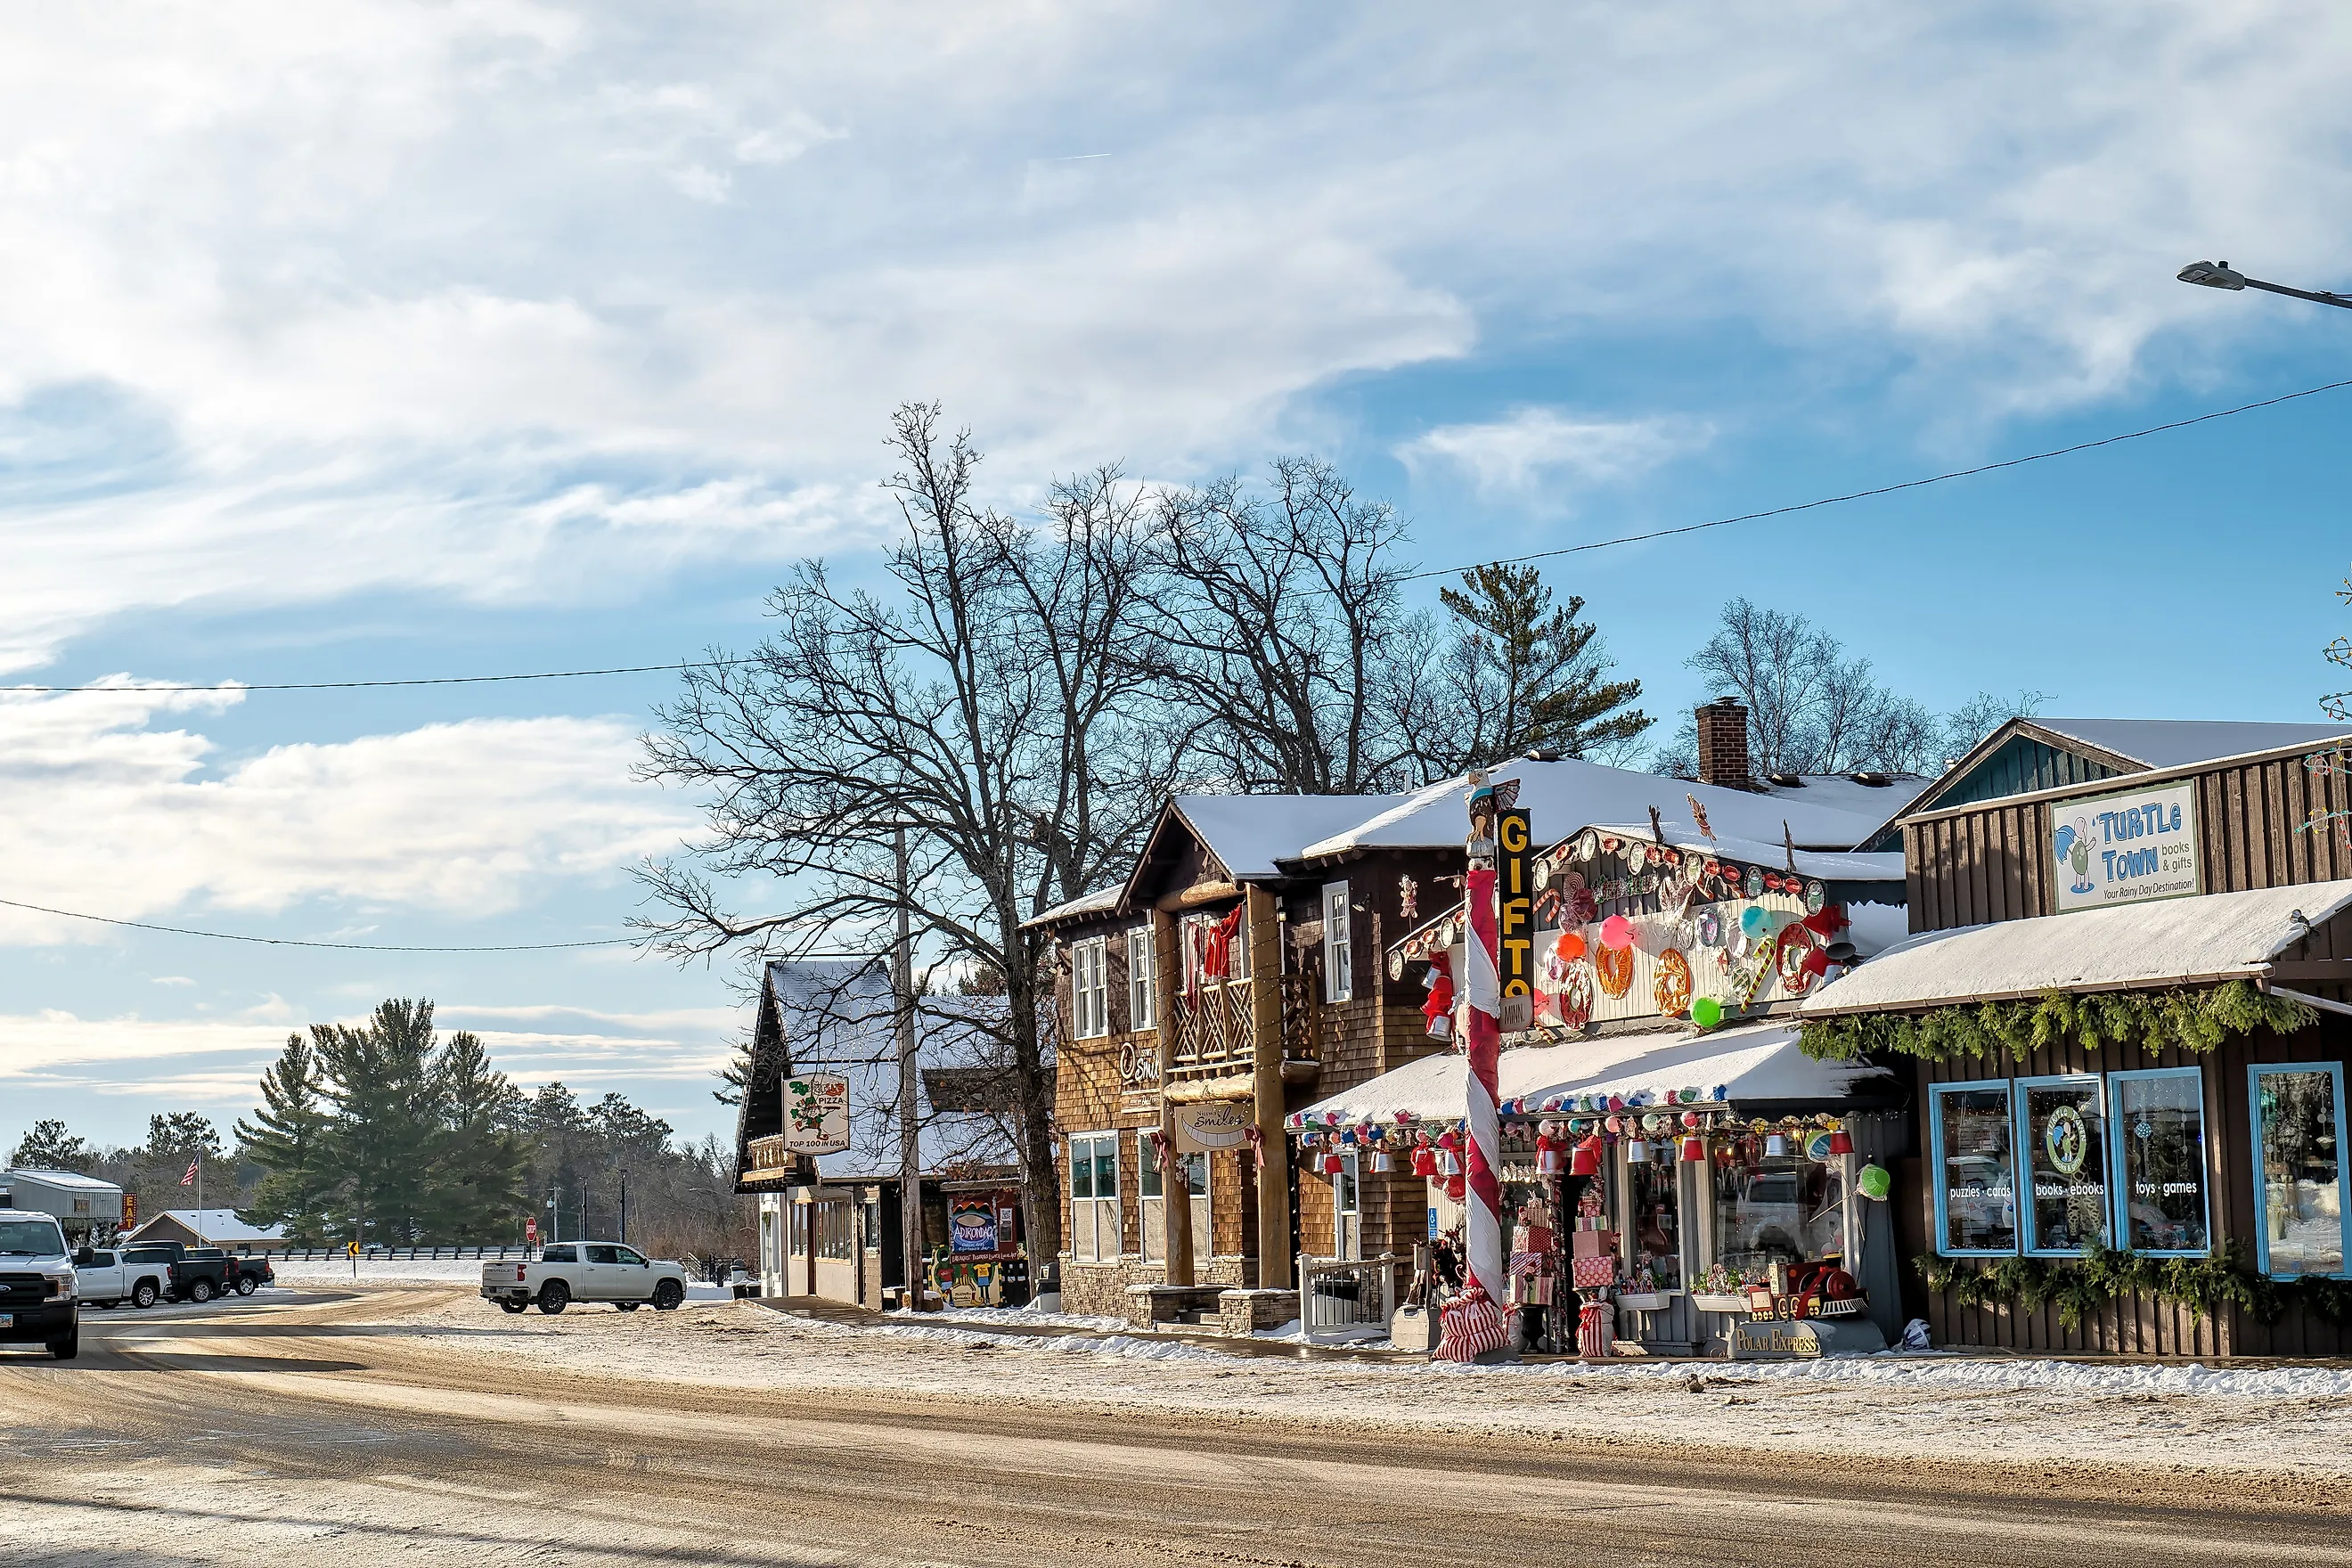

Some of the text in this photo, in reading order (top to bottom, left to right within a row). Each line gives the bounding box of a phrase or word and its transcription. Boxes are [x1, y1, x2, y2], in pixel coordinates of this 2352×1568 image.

[2161, 842, 2190, 856] books
[2162, 857, 2193, 873] & gifts
[2103, 877, 2194, 900] Your Rainy Day Destination!
[1503, 1003, 1525, 1025] MINN.
[819, 1097, 844, 1105] PIZZA
[1949, 1184, 2011, 1201] puzzles cards
[2035, 1181, 2104, 1196] books ebooks
[2136, 1181, 2197, 1197] toys games
[126, 1196, 134, 1229] EAT
[527, 1224, 536, 1234] STOP
